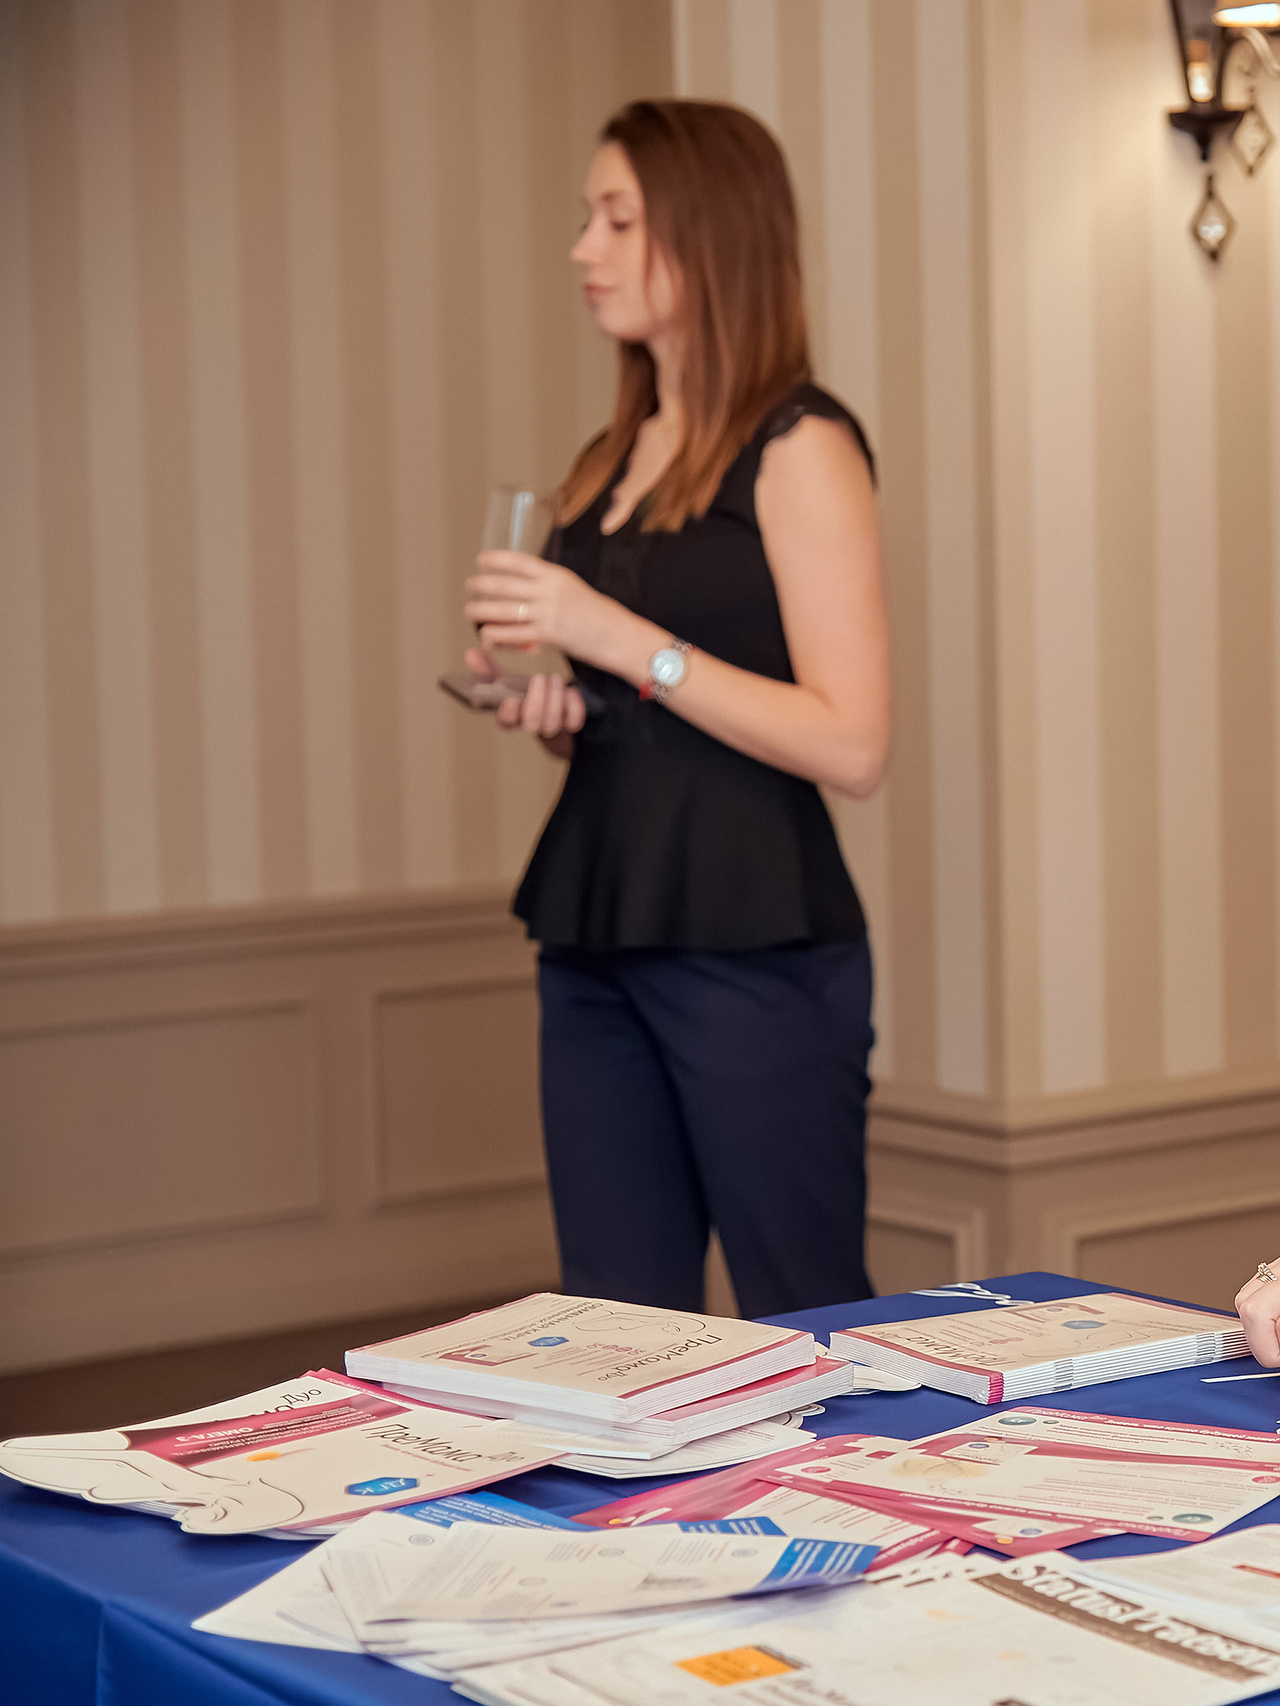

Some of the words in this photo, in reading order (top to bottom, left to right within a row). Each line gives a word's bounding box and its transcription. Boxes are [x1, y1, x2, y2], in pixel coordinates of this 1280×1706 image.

[620, 1335, 723, 1370] ПреМама
[281, 1388, 322, 1405] Дуо
[175, 1427, 254, 1443] ОМЕГА-3
[361, 1424, 482, 1462] ПреМама
